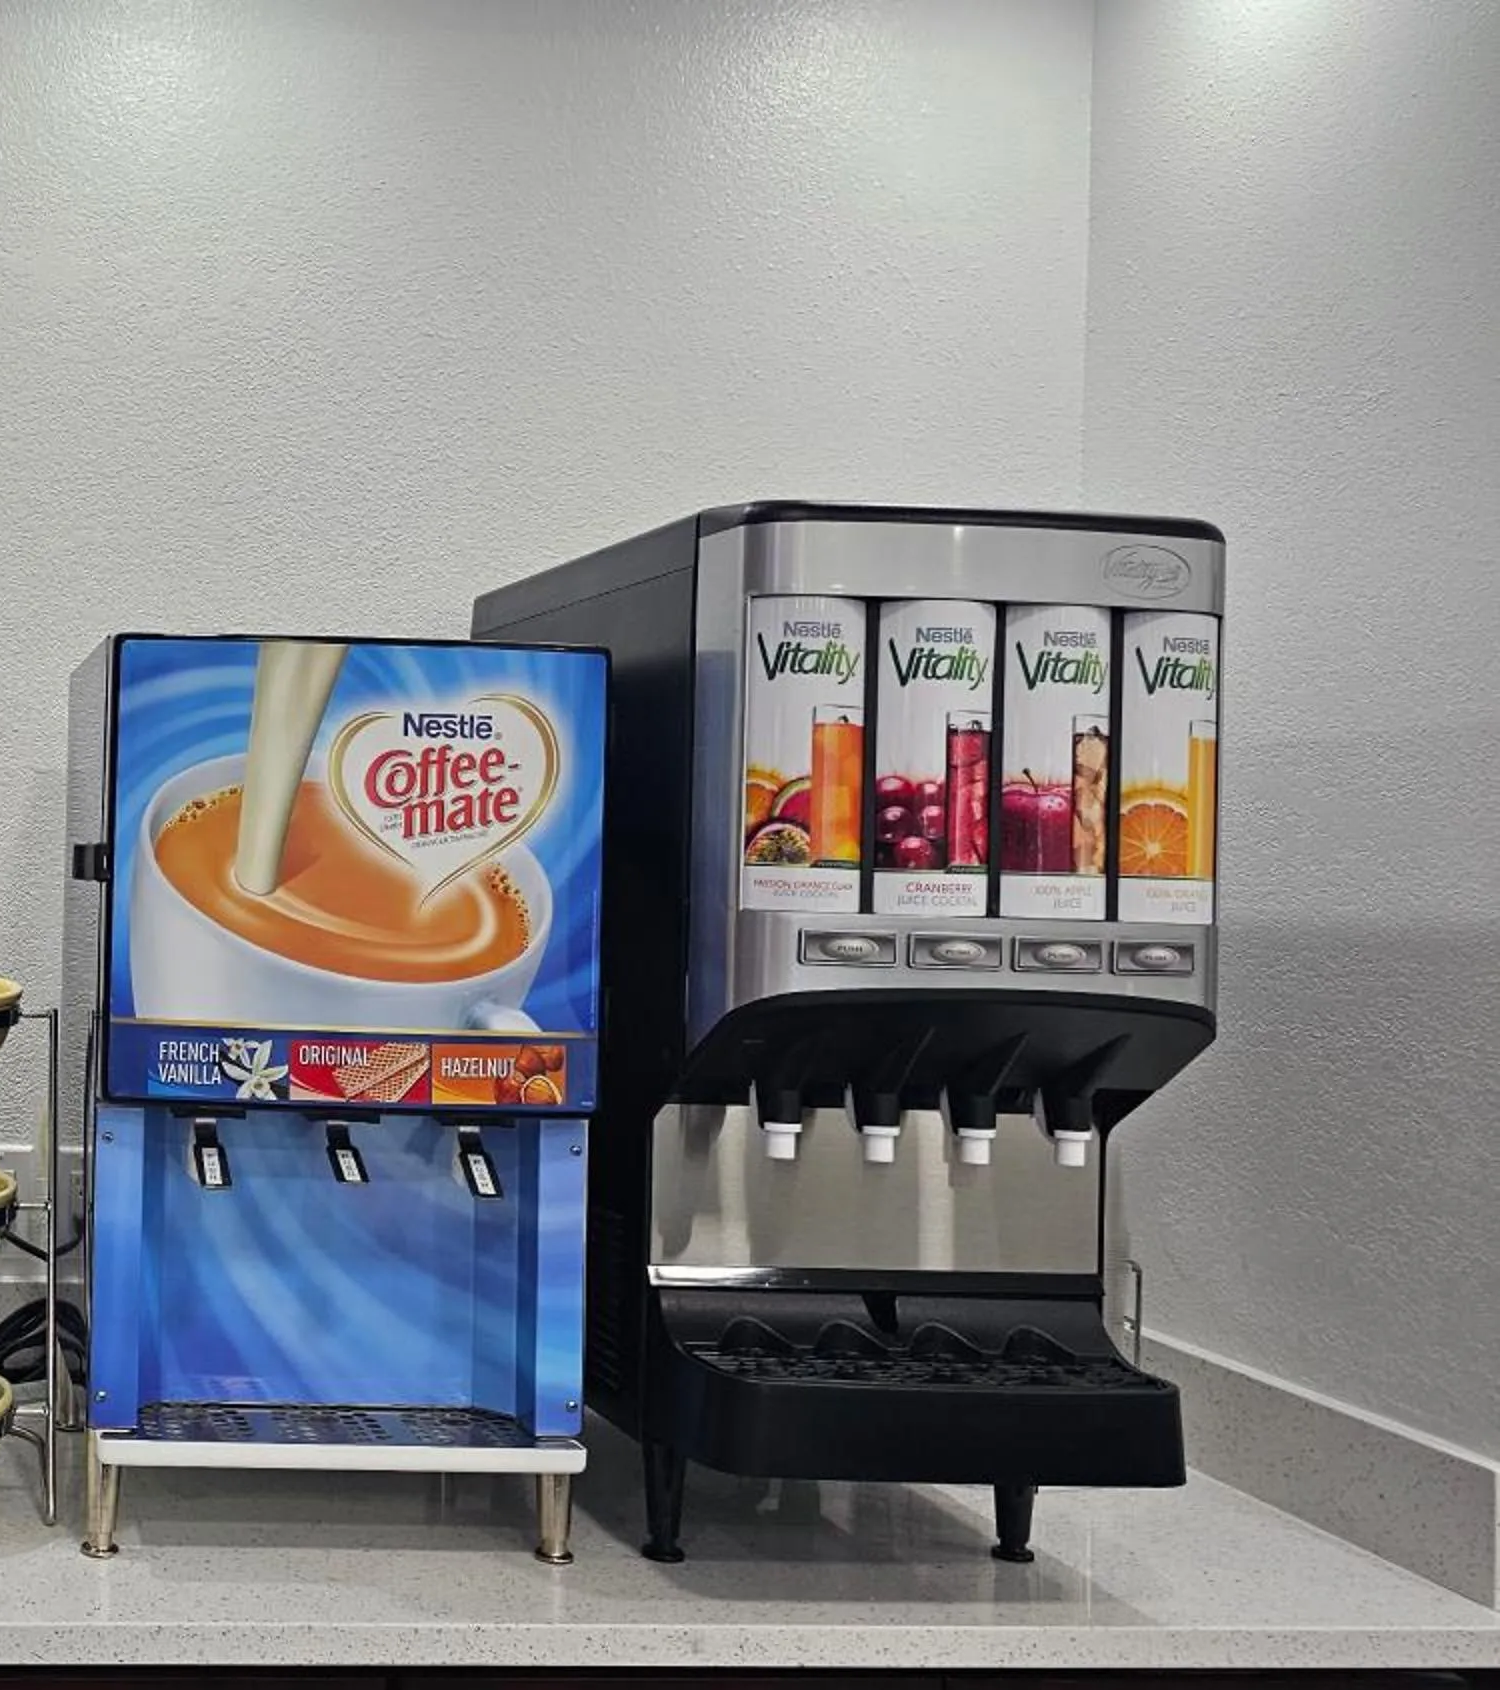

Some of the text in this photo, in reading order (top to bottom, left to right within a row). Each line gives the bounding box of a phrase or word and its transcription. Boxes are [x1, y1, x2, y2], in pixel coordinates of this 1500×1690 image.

[783, 621, 841, 638] Nestlé
[915, 627, 973, 644] Nestlé
[1043, 631, 1097, 648] Nestlé
[757, 632, 860, 685] Vitality
[889, 637, 988, 690] Vitality
[1015, 641, 1108, 694] Vitality
[403, 712, 493, 739] Nestlé
[402, 786, 519, 840] mate
[905, 882, 973, 894] CRANBERRY
[159, 1041, 219, 1063] FRENCH
[299, 1045, 370, 1067] ORIGINAL
[158, 1064, 222, 1084] VANILLA
[441, 1056, 517, 1078] HAZELNUT
